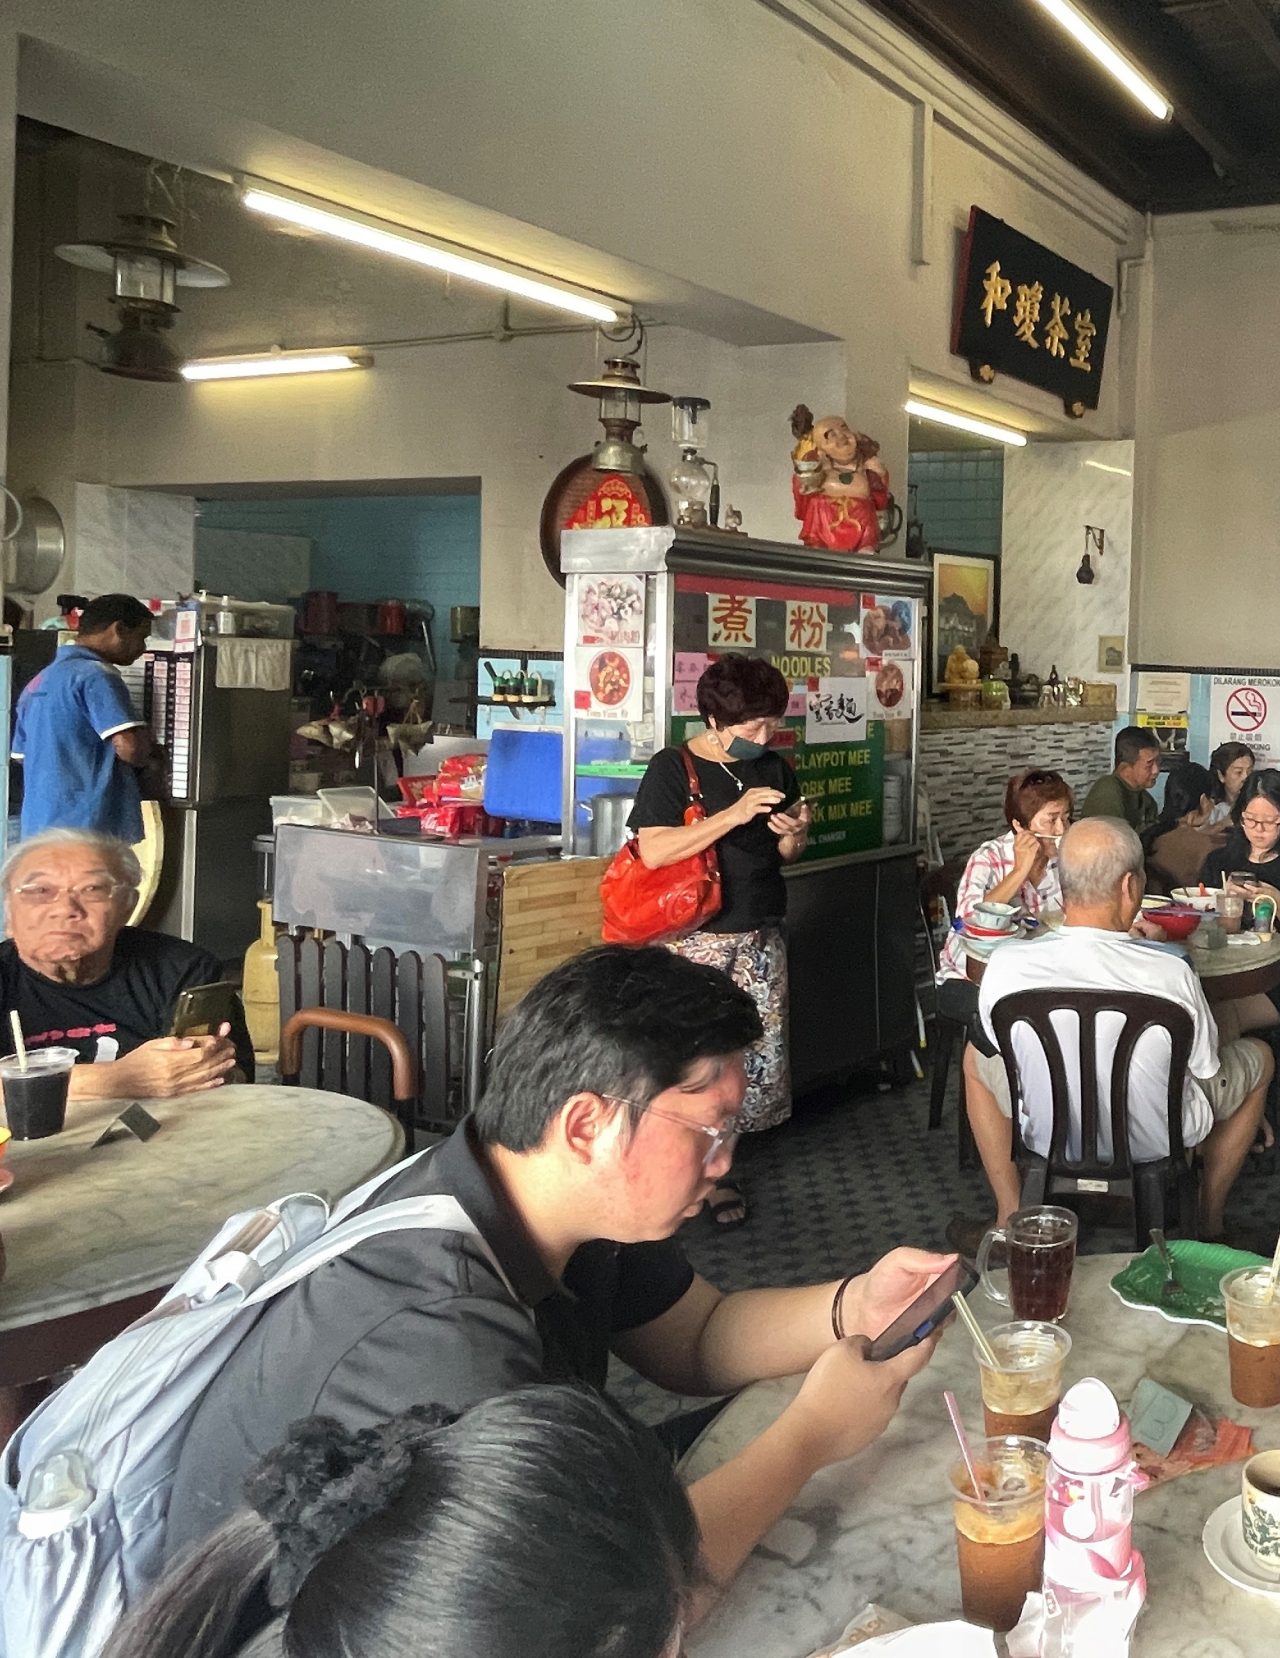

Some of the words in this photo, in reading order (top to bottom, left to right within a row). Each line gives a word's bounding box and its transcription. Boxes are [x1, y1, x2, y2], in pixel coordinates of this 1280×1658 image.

[1213, 677, 1247, 687] DILARANG
[1247, 678, 1280, 688] MEROKOK
[848, 749, 871, 767] MEE
[799, 779, 826, 796] ORK
[828, 777, 853, 794] MEE
[849, 799, 873, 817] MEE
